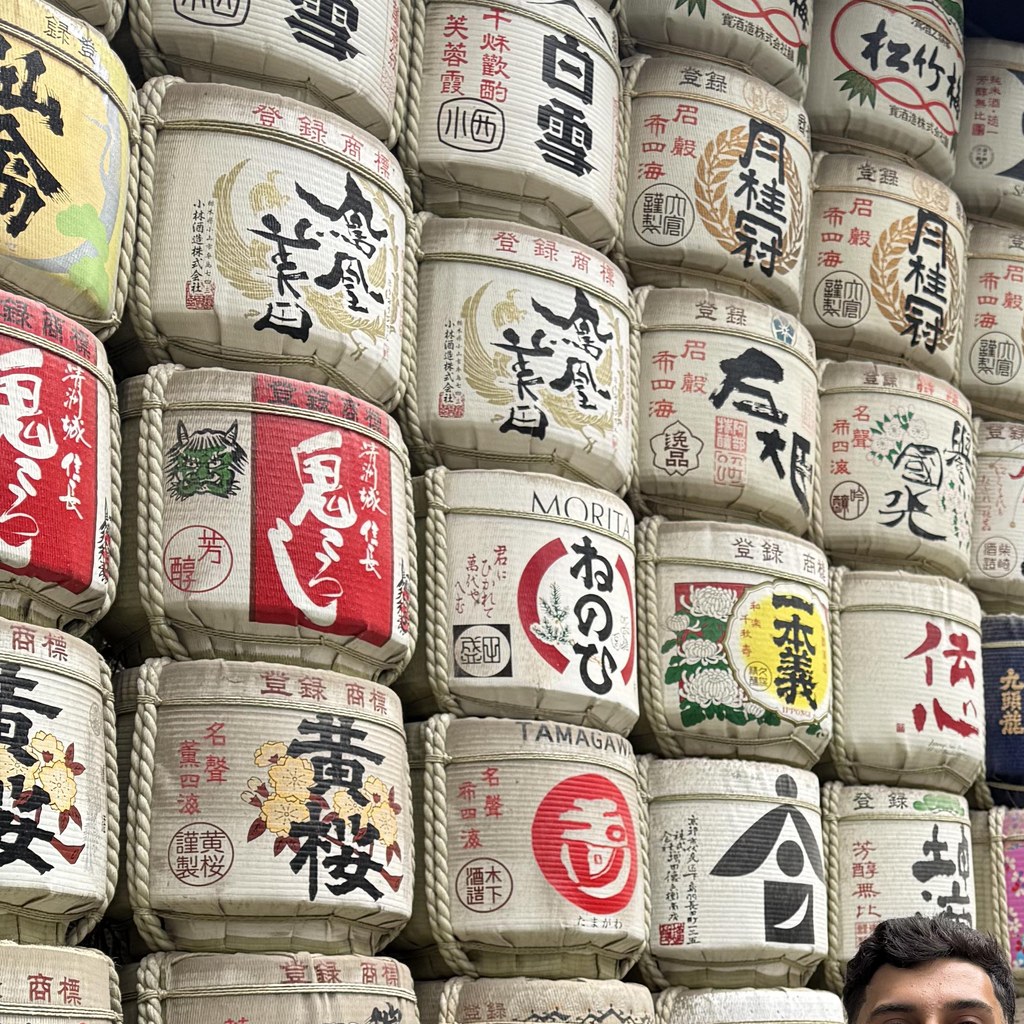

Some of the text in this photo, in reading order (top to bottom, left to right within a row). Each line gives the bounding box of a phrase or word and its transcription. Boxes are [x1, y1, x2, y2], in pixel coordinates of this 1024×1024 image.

[534, 34, 600, 178] 白雪
[679, 66, 729, 94] 登録
[860, 18, 963, 121] 松竹梅
[252, 103, 393, 181] 登録商標
[730, 118, 788, 278] 月桂冠
[493, 230, 616, 289] 登録商標
[900, 207, 949, 355] 月桂冠
[531, 489, 632, 541] MORITA
[771, 593, 818, 711] 一本義
[904, 620, 979, 738] 伝心
[260, 670, 389, 716] 登録商標
[286, 713, 387, 903] 黄桜
[852, 791, 909, 811] 登録
[199, 829, 226, 879] 黄桜
[484, 866, 503, 905] 木下
[851, 839, 882, 919] 芳醇無比
[576, 914, 624, 931] たまがわ
